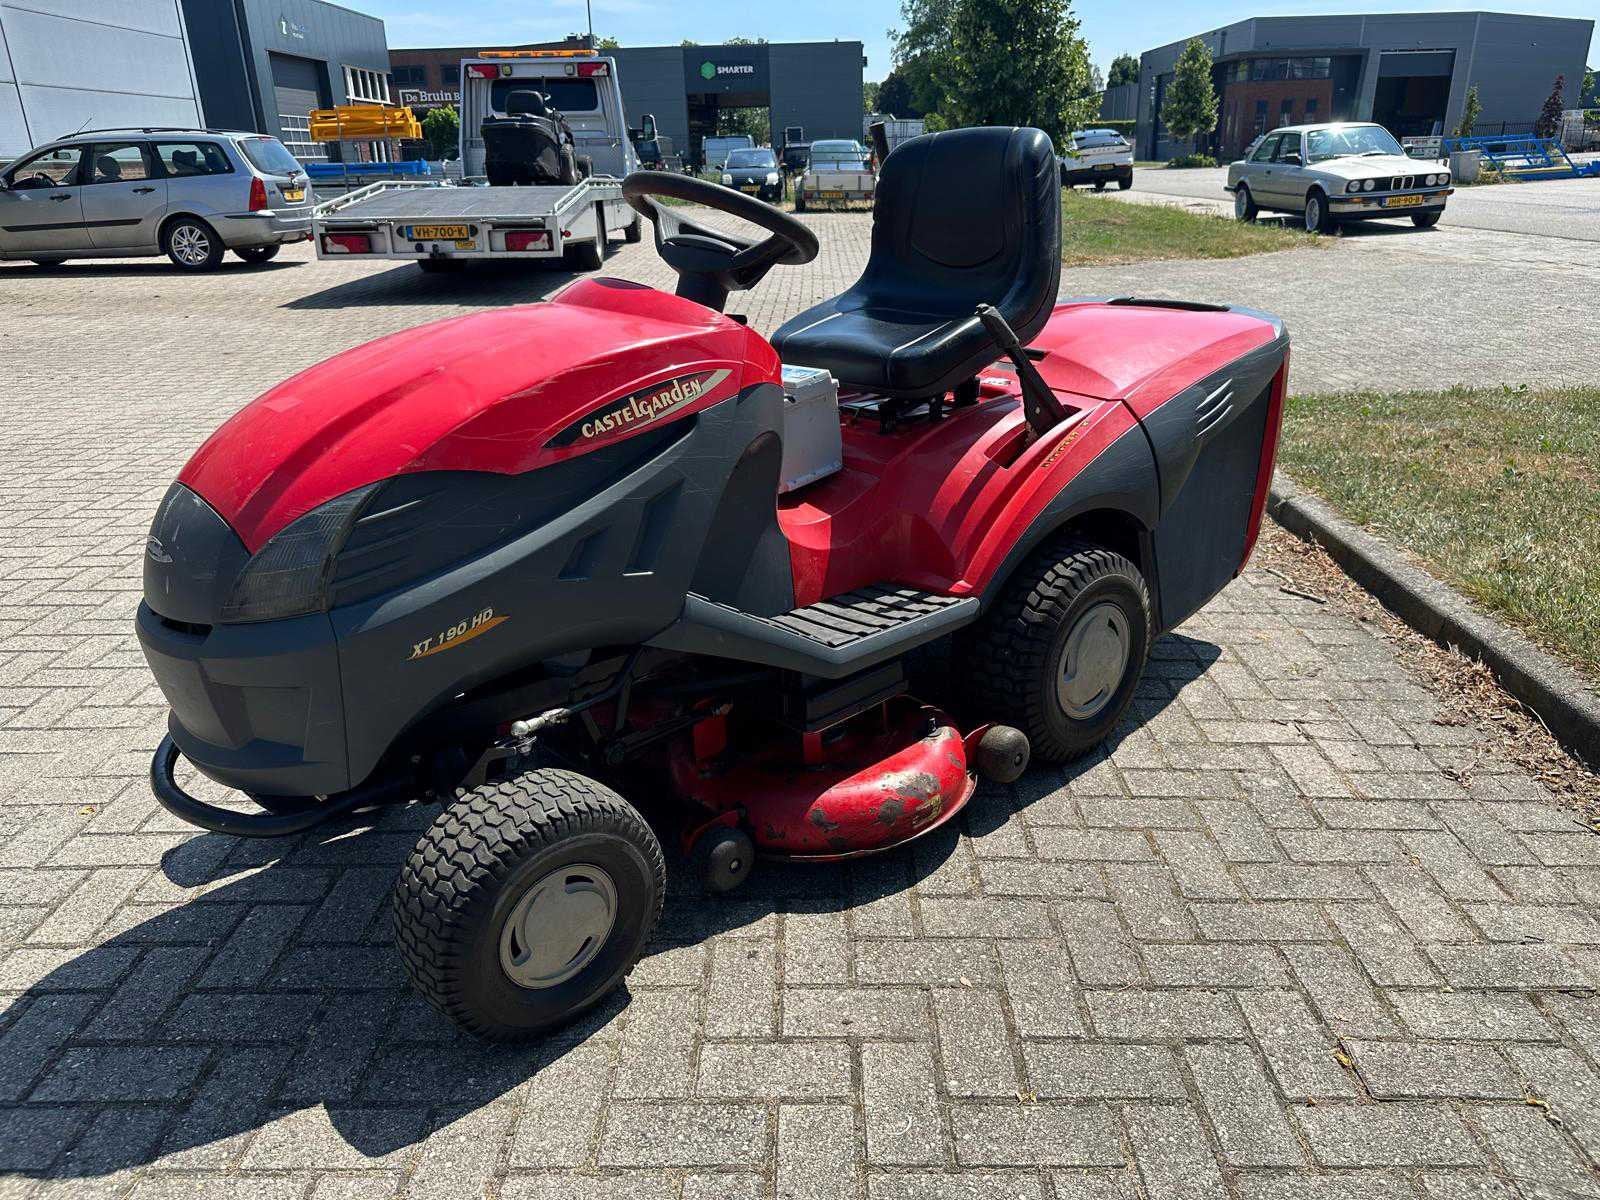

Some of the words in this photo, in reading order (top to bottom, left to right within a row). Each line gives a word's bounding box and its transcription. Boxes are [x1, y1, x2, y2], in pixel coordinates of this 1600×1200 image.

[717, 65, 754, 74] SMARTER
[405, 93, 418, 102] De
[420, 91, 453, 101] Bruin
[415, 227, 465, 238] VH-700-K
[411, 637, 433, 658] XT
[438, 621, 467, 645] 190
[471, 608, 493, 629] HD
